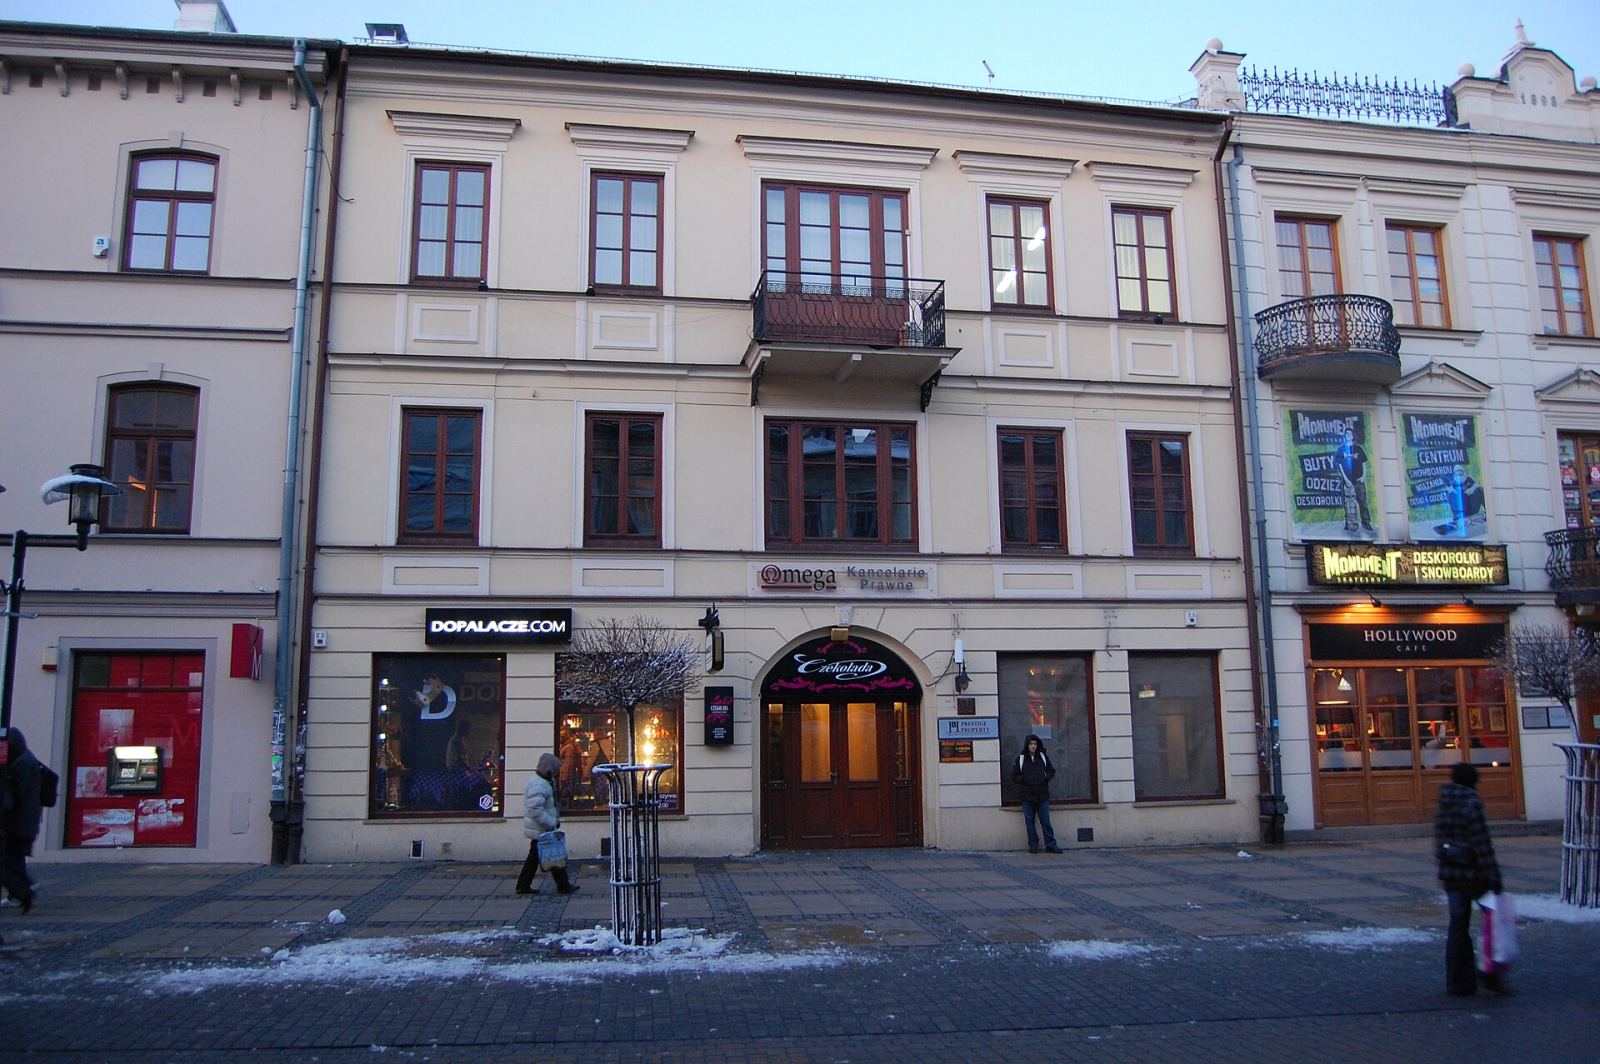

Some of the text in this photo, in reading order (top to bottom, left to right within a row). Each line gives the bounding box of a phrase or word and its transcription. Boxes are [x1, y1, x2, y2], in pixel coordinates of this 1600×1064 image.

[1410, 416, 1468, 442] MONUMENT
[1418, 450, 1465, 464] CENTRUM
[1303, 456, 1335, 472] BUTY
[1306, 477, 1342, 491] ODZIEŻ
[1296, 495, 1343, 505] DESKOROLKI
[1323, 548, 1402, 580] MONUMENT
[1413, 551, 1480, 564] DESKOROLKI
[847, 566, 925, 578] Kancelarie
[1414, 566, 1494, 579] I SNOWBOARDY
[859, 579, 914, 590] Prawne
[431, 620, 566, 633] DOPALACZE.COM
[1364, 630, 1457, 641] HOLLYWOOD
[793, 653, 887, 681] Czekolada
